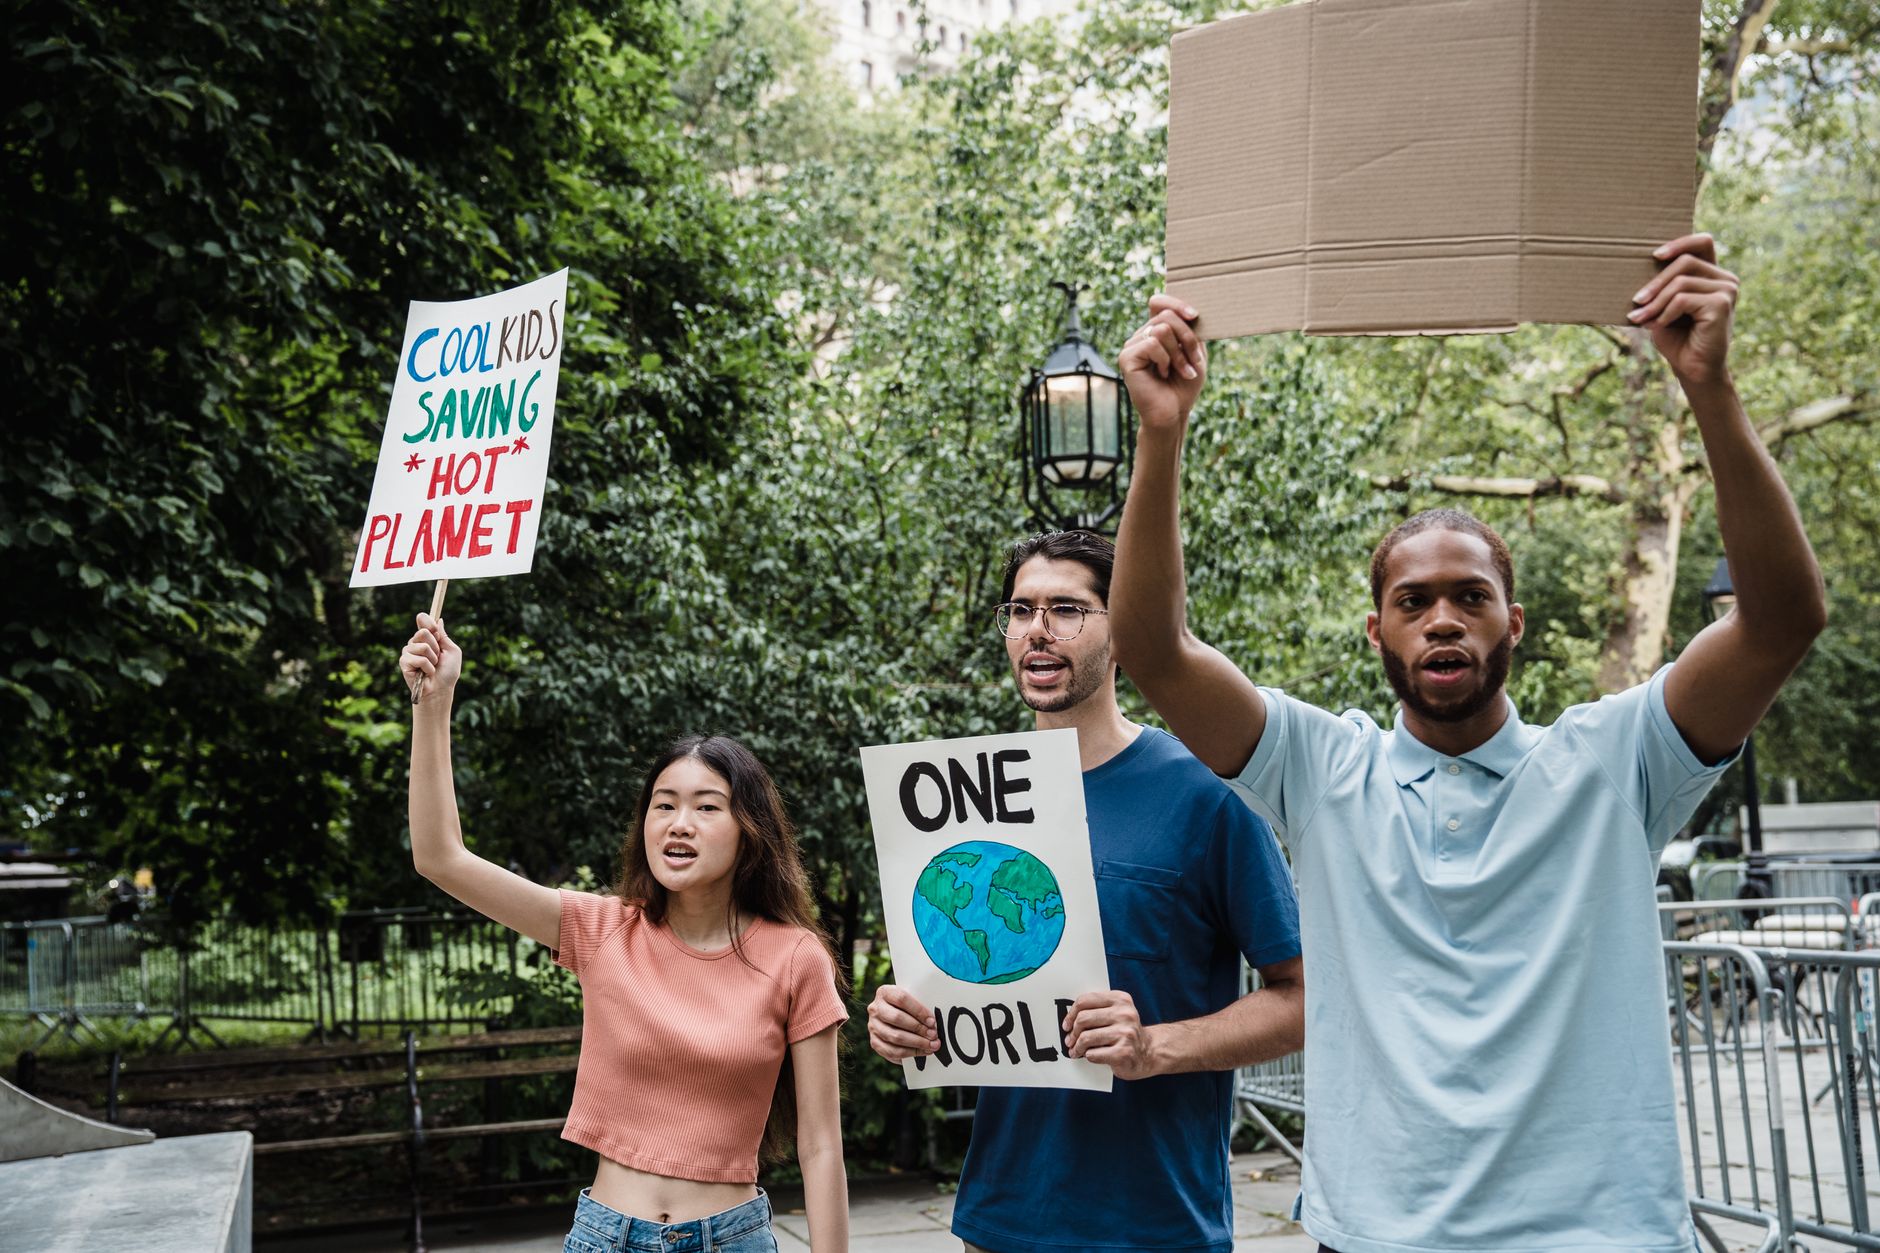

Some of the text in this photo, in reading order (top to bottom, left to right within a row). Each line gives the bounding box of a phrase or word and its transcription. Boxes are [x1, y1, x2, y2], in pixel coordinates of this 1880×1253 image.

[406, 299, 558, 383] COOL KIDS
[403, 369, 541, 444] SAVING
[360, 499, 533, 573] PLANET
[899, 749, 1035, 832] ONE
